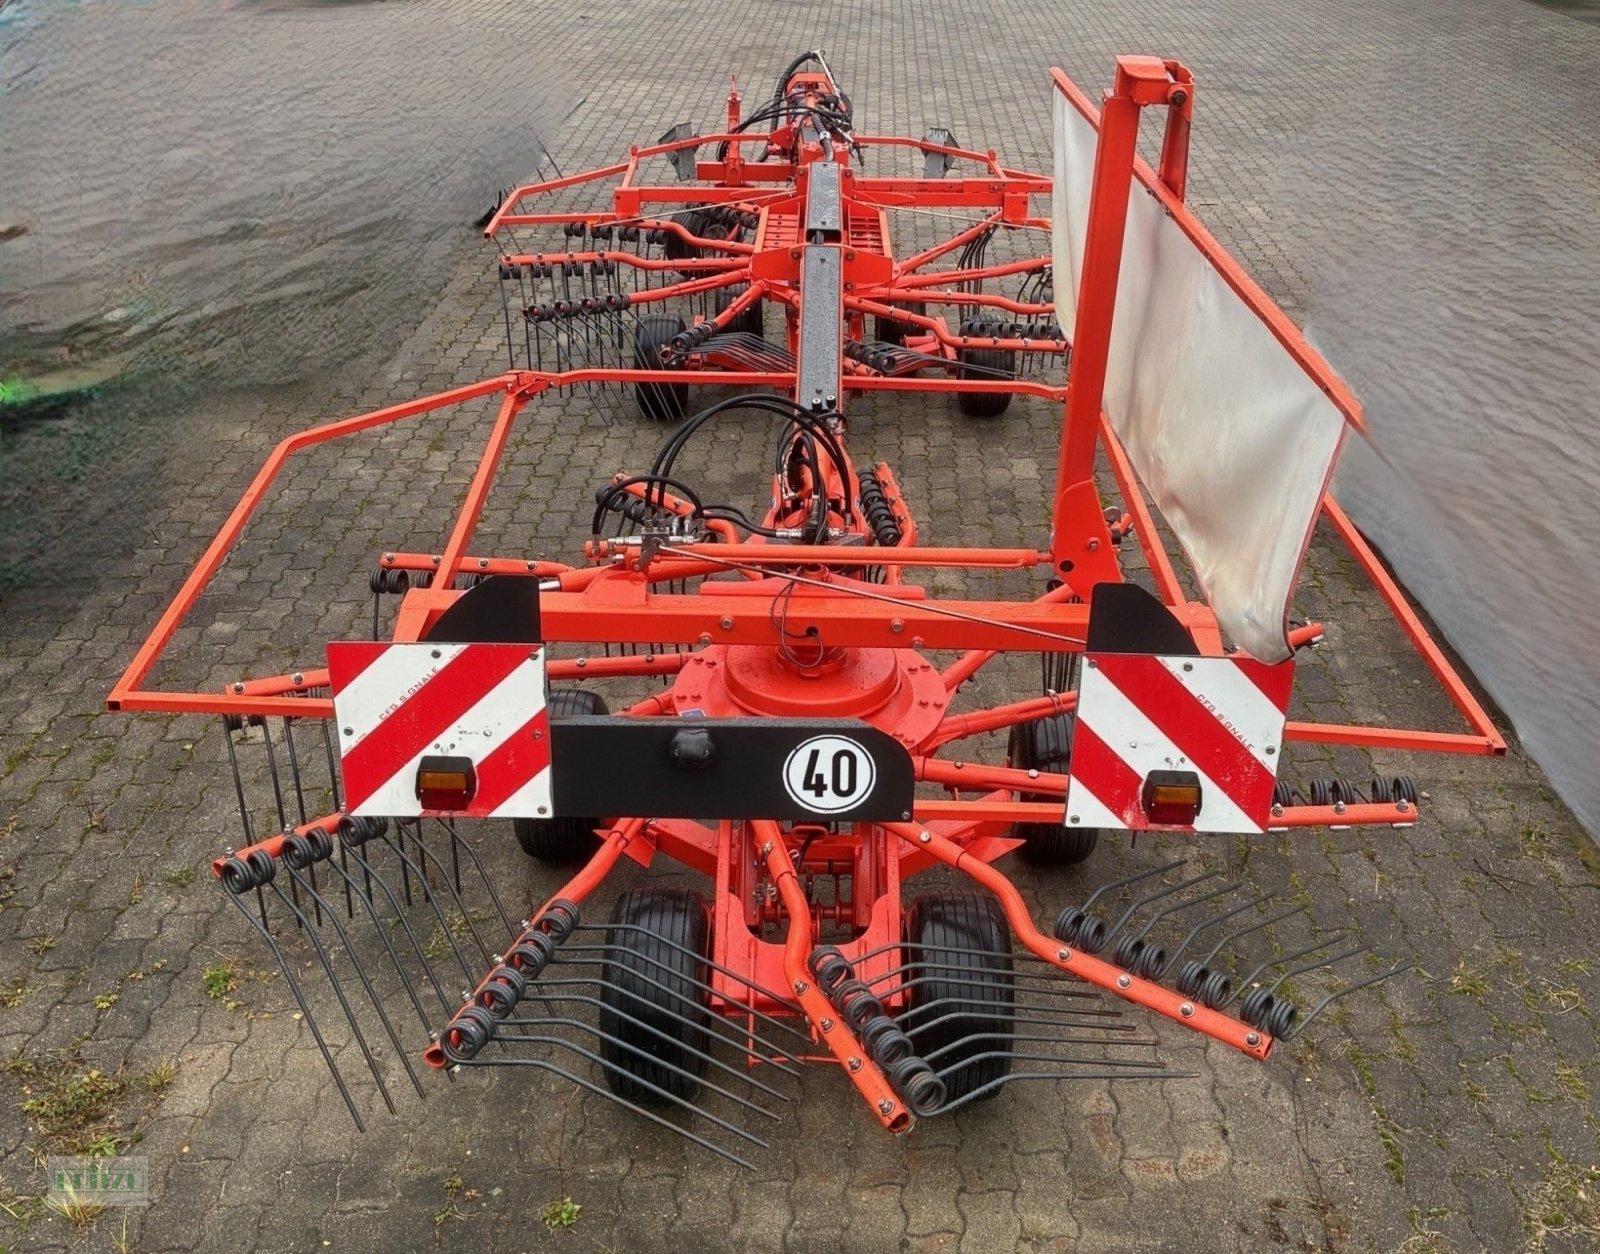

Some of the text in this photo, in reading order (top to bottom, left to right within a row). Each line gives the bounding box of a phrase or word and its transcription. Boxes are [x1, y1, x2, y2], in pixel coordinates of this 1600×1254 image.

[379, 703, 399, 721] CFG
[1197, 693, 1217, 713] CFG
[803, 749, 857, 798] 40
